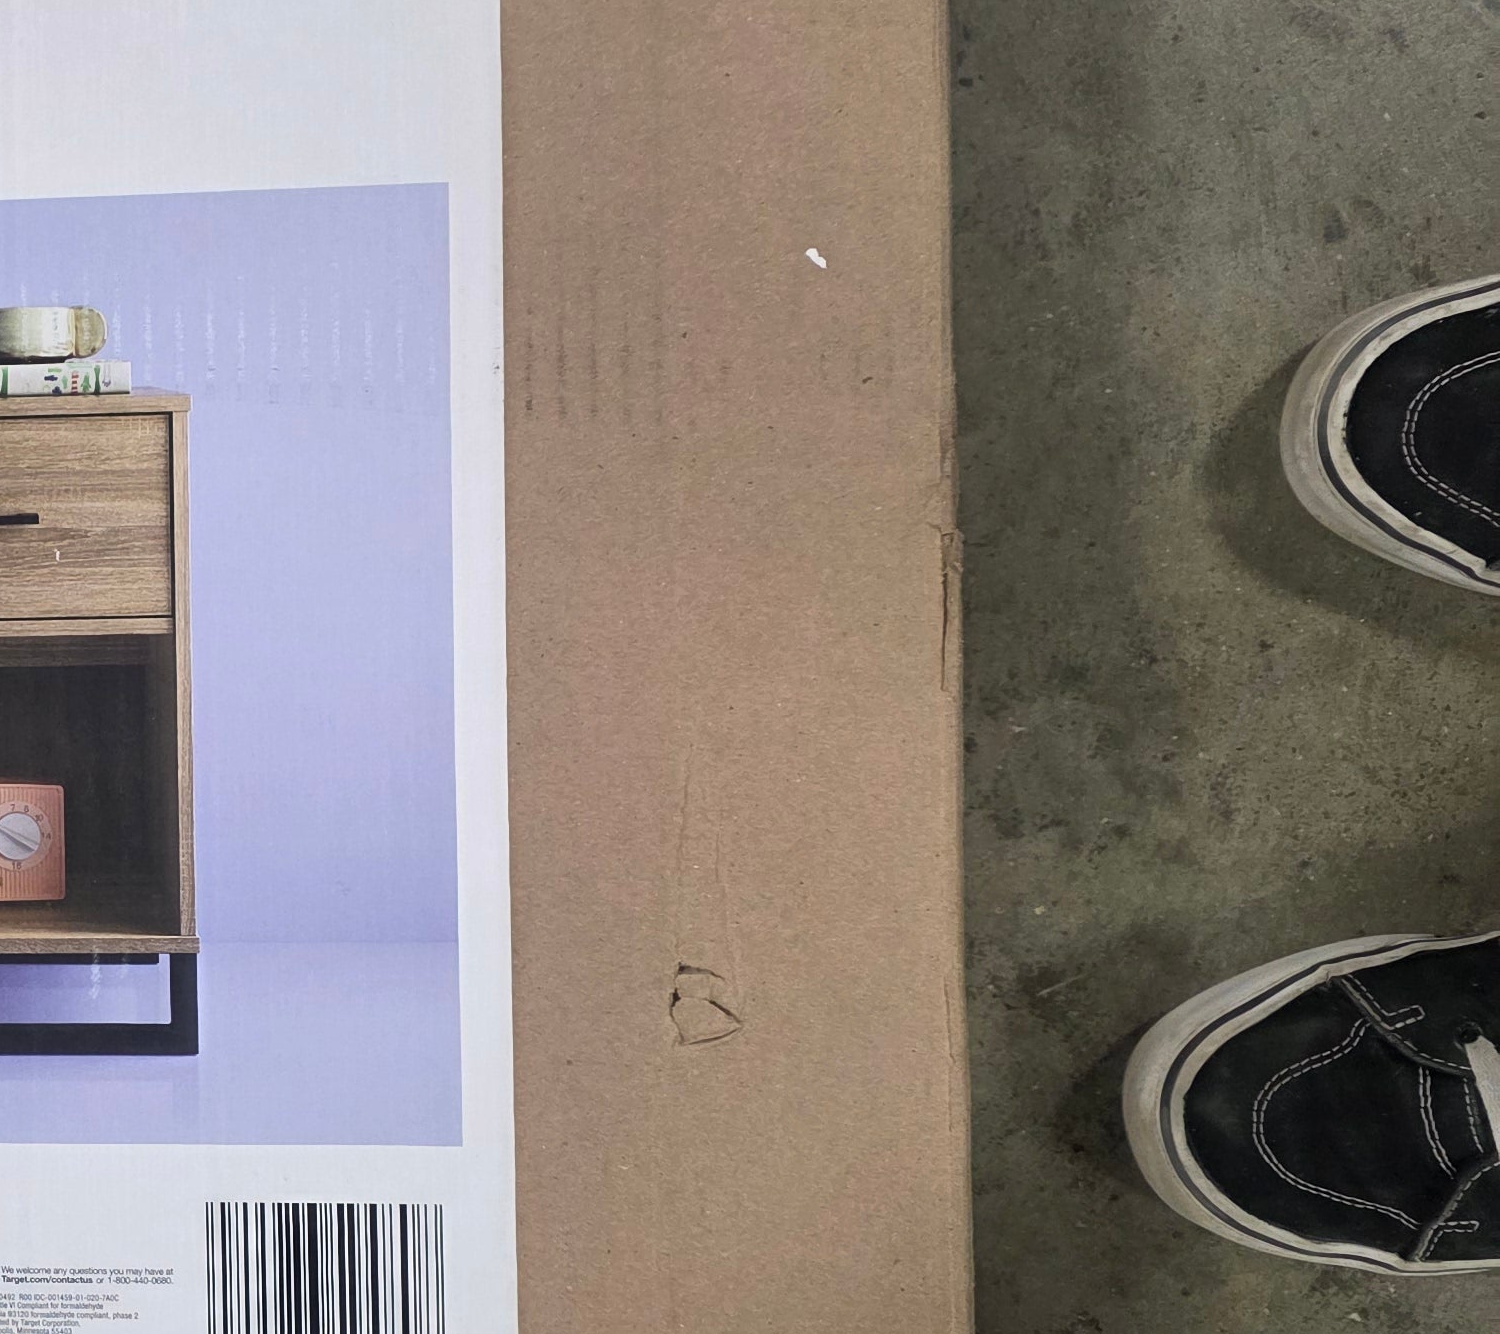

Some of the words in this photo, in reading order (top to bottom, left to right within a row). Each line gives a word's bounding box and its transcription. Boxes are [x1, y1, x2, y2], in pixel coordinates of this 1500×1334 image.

[1, 1266, 14, 1275] We
[16, 1266, 50, 1275] welcome
[53, 1267, 67, 1277] any
[69, 1267, 107, 1276] questions
[109, 1268, 124, 1277] you
[126, 1268, 143, 1277] may
[145, 1267, 164, 1276] have
[166, 1268, 174, 1276] at
[2, 1275, 93, 1285] Target.com/contactus
[17, 1302, 49, 1310] Compliant
[61, 1302, 103, 1310] formaldehyde
[31, 1311, 75, 1319] formaldehyde
[12, 1319, 18, 1327] by
[21, 1319, 41, 1327] Target
[42, 1320, 80, 1328] Corporation,
[17, 1327, 50, 1334] Minnesota
